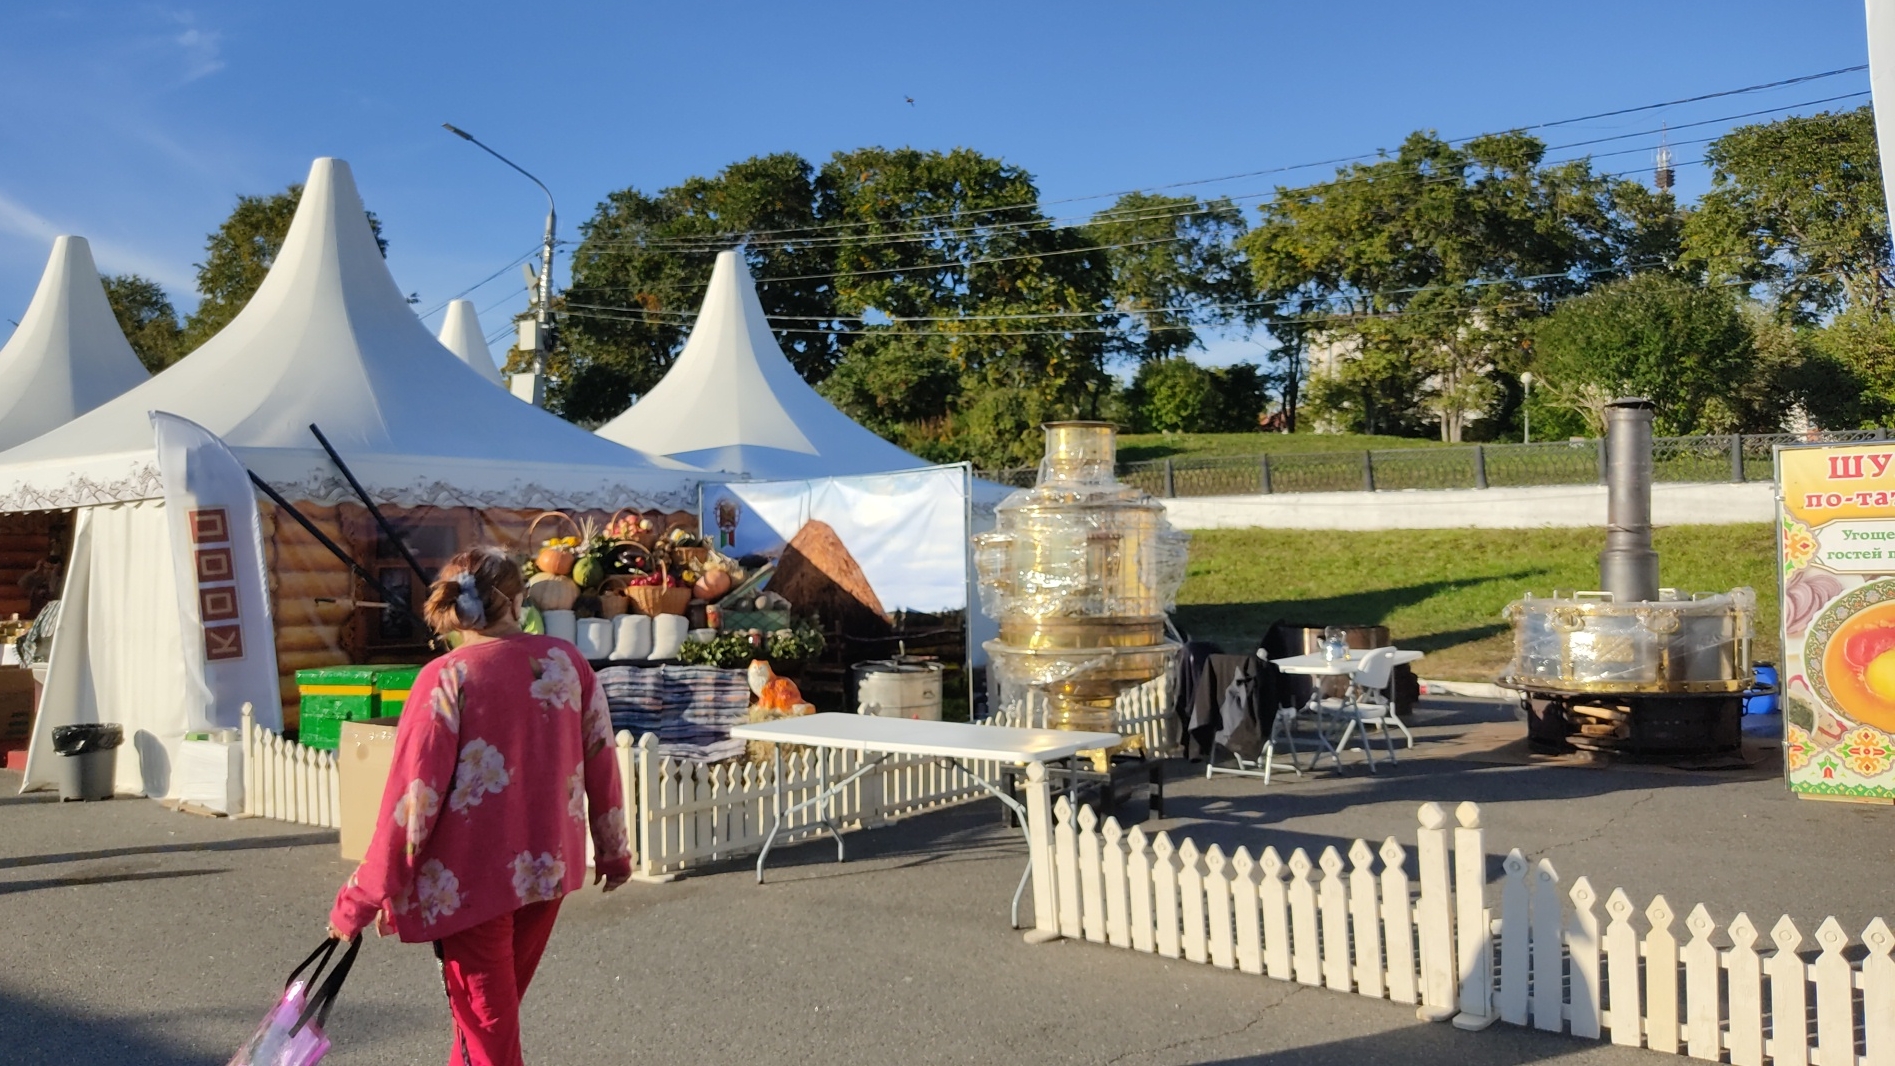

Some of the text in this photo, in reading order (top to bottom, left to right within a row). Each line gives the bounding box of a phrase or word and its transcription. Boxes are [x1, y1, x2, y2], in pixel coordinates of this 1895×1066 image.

[1828, 453, 1893, 479] ШУ
[1805, 491, 1895, 508] по-та
[1826, 547, 1882, 560] гостей
